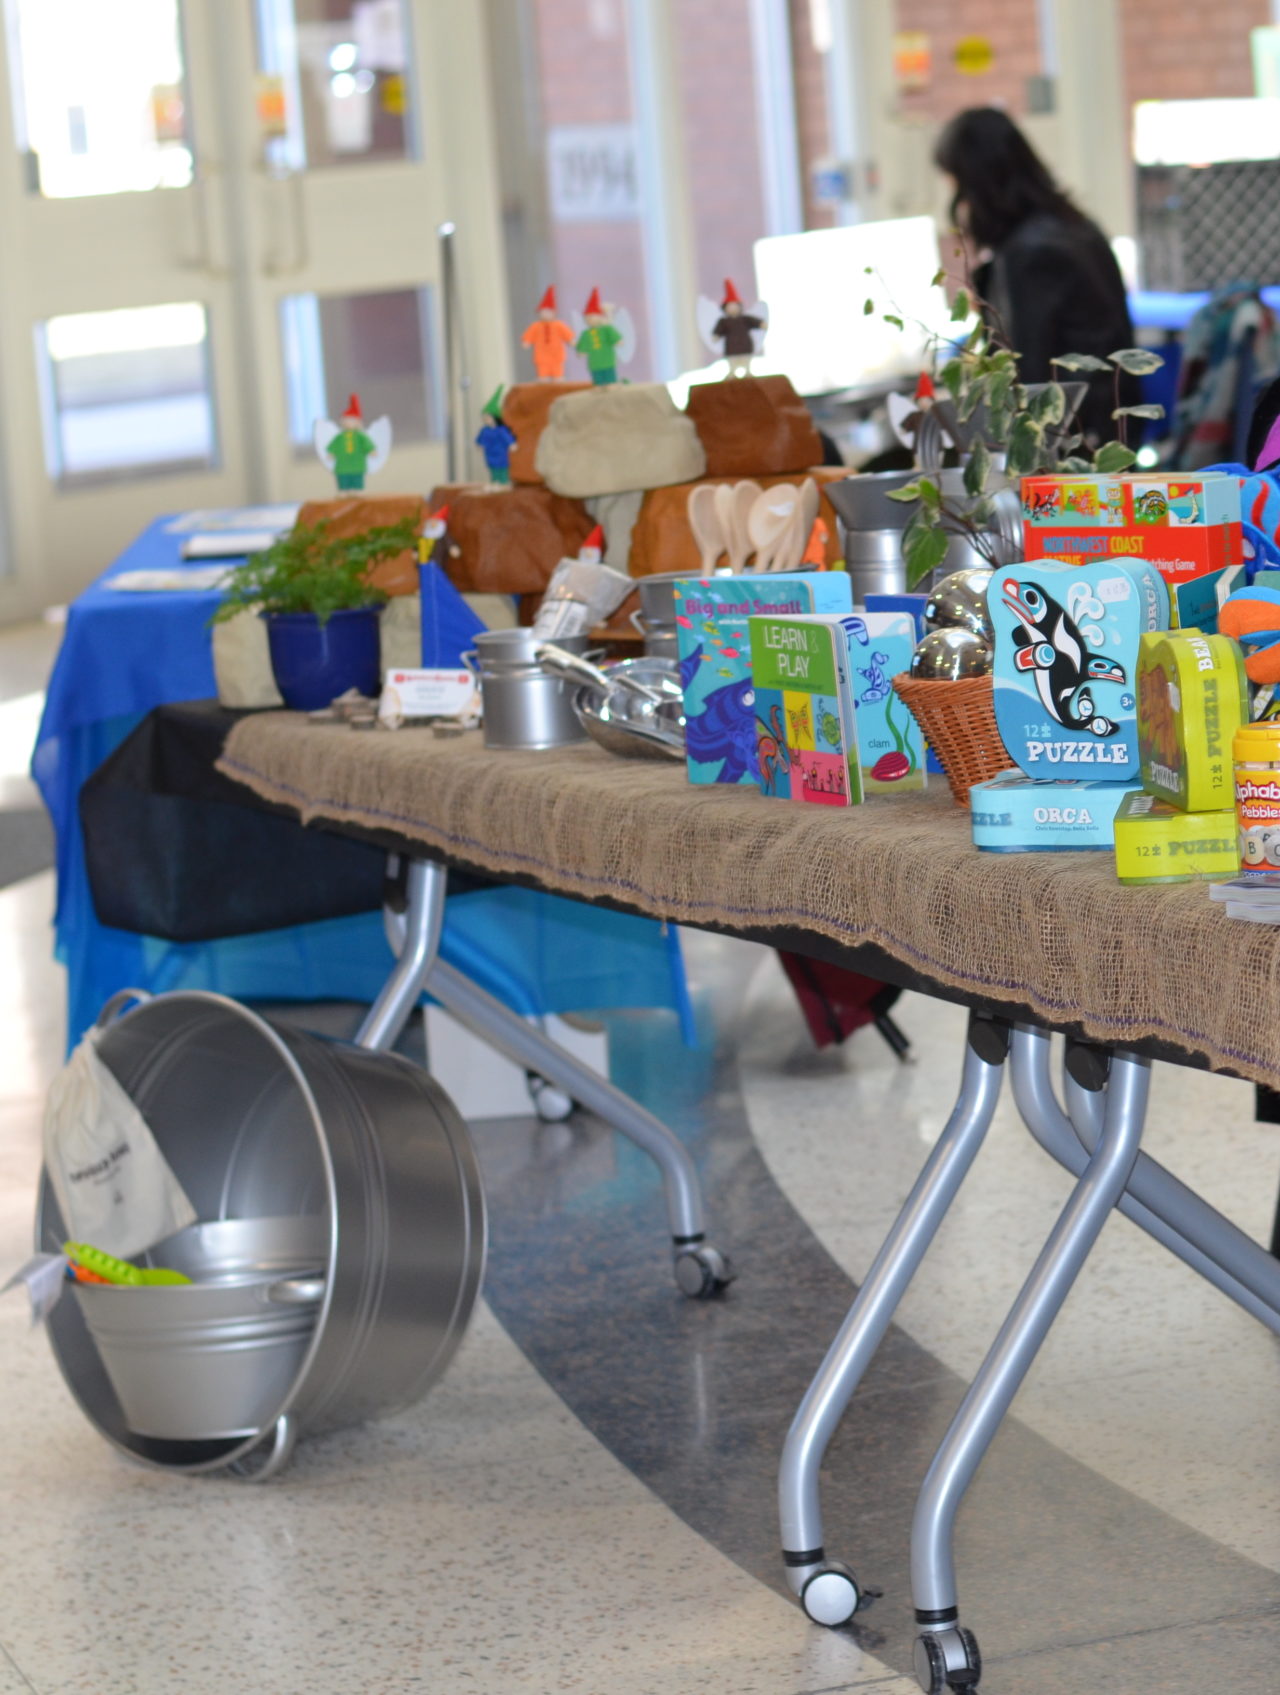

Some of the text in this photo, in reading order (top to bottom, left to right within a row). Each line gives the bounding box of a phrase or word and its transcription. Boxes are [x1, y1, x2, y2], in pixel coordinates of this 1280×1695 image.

[1043, 536, 1144, 554] NORTHWEST COAST
[1147, 558, 1174, 573] tching
[1175, 558, 1196, 571] Game
[685, 599, 802, 620] Big and Small
[763, 625, 808, 652] LEARN
[778, 653, 811, 679] PLAY
[1121, 696, 1134, 708] 3+
[1024, 724, 1040, 738] 12
[868, 737, 890, 749] clam
[1026, 741, 1129, 764] PUZZLE
[972, 812, 1012, 826] ZZLE
[1034, 807, 1093, 824] ORCA
[1136, 839, 1238, 857] 12 PUZZL
